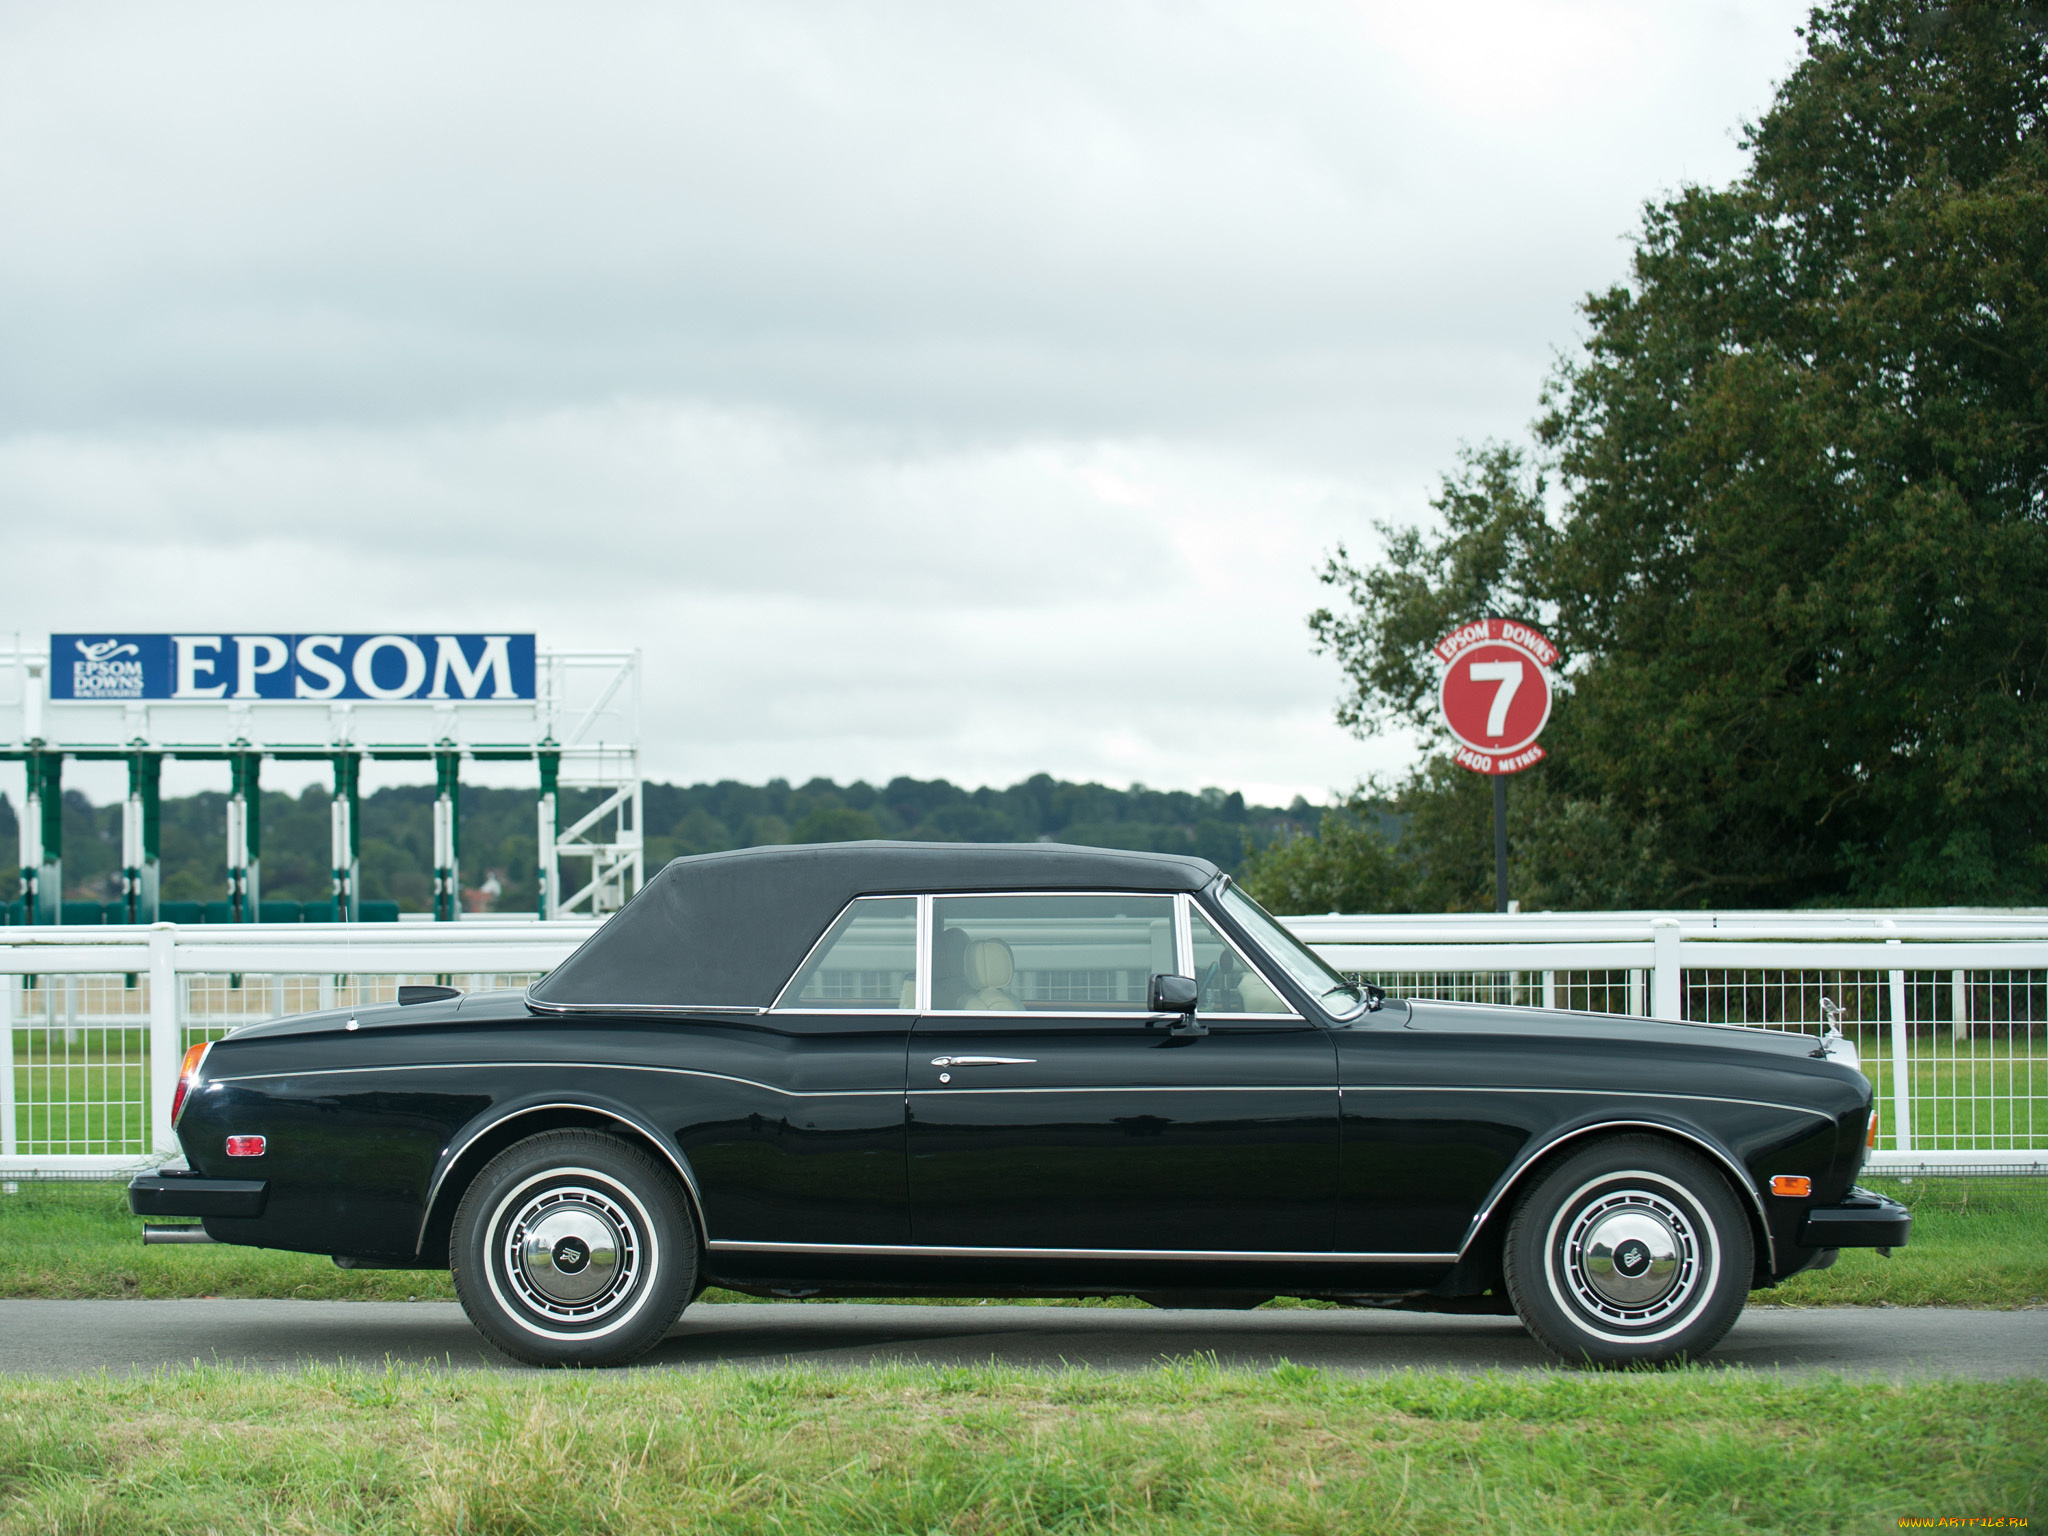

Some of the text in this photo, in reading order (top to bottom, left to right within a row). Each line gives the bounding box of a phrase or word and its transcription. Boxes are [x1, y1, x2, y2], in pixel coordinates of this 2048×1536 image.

[1439, 623, 1554, 662] EPSOM DOWNS
[73, 661, 143, 676] EPSOM
[73, 675, 144, 689] DOWNS
[172, 635, 518, 699] EPSOM
[1469, 661, 1523, 737] 7
[1457, 746, 1542, 772] 1400 METRES
